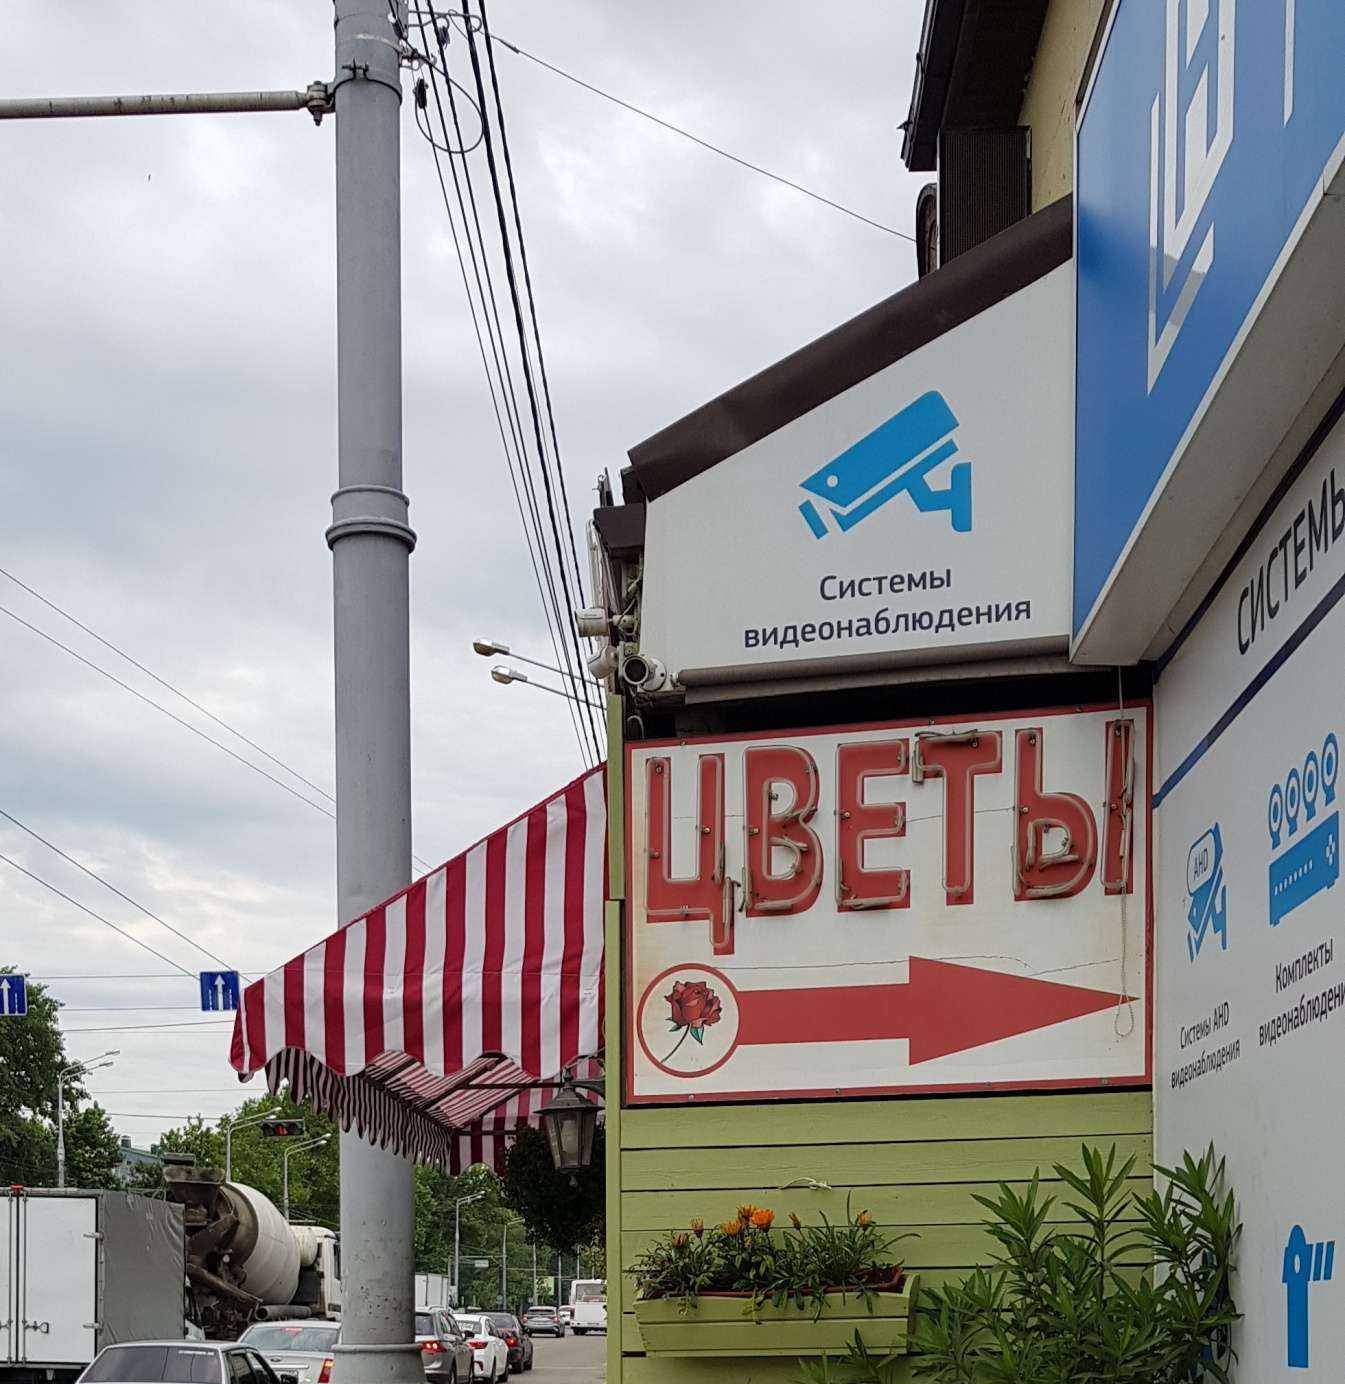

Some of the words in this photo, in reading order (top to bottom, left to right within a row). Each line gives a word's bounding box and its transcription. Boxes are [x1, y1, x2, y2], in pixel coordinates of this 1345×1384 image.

[819, 569, 951, 600] Системы
[744, 600, 1031, 649] видеонаблюдения
[646, 719, 1136, 956] ЦВЕТЫ
[1193, 848, 1209, 881] AHD
[1276, 938, 1334, 993] Комплекты
[1180, 1016, 1212, 1050] Системы
[1213, 1001, 1230, 1033] AHD
[1171, 1039, 1241, 1089] видеонаблюдения
